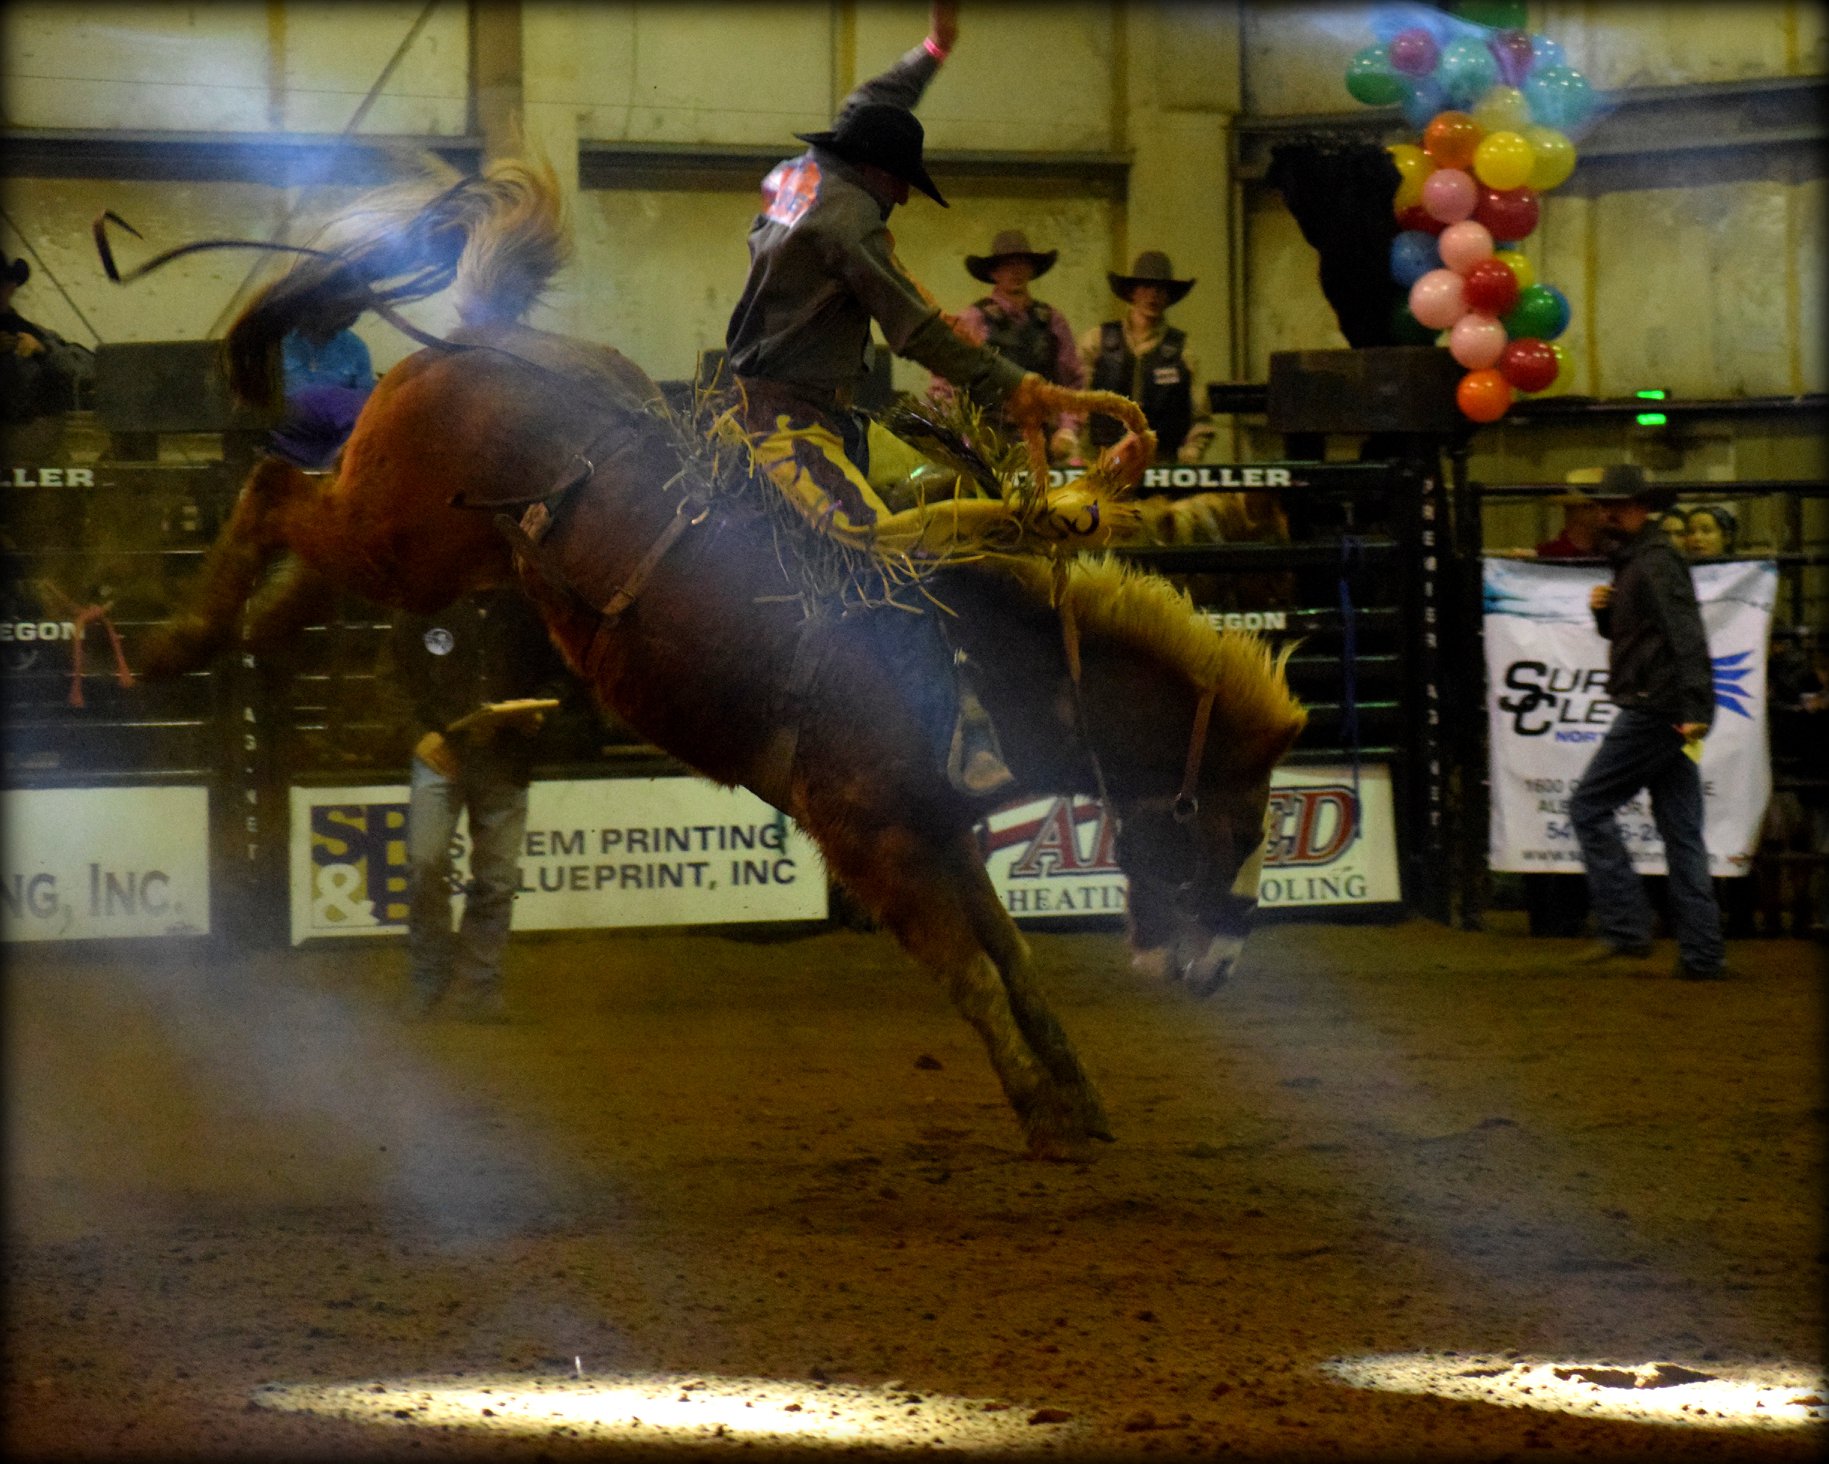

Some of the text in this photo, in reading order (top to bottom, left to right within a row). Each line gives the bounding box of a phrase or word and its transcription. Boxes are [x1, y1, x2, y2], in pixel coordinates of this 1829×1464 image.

[1144, 468, 1292, 488] HOLLER
[1206, 611, 1287, 631] EGON
[602, 824, 779, 852] PRINTING
[516, 861, 717, 892] LUEPRINT,
[733, 858, 797, 886] INC
[1261, 875, 1367, 902] OLING
